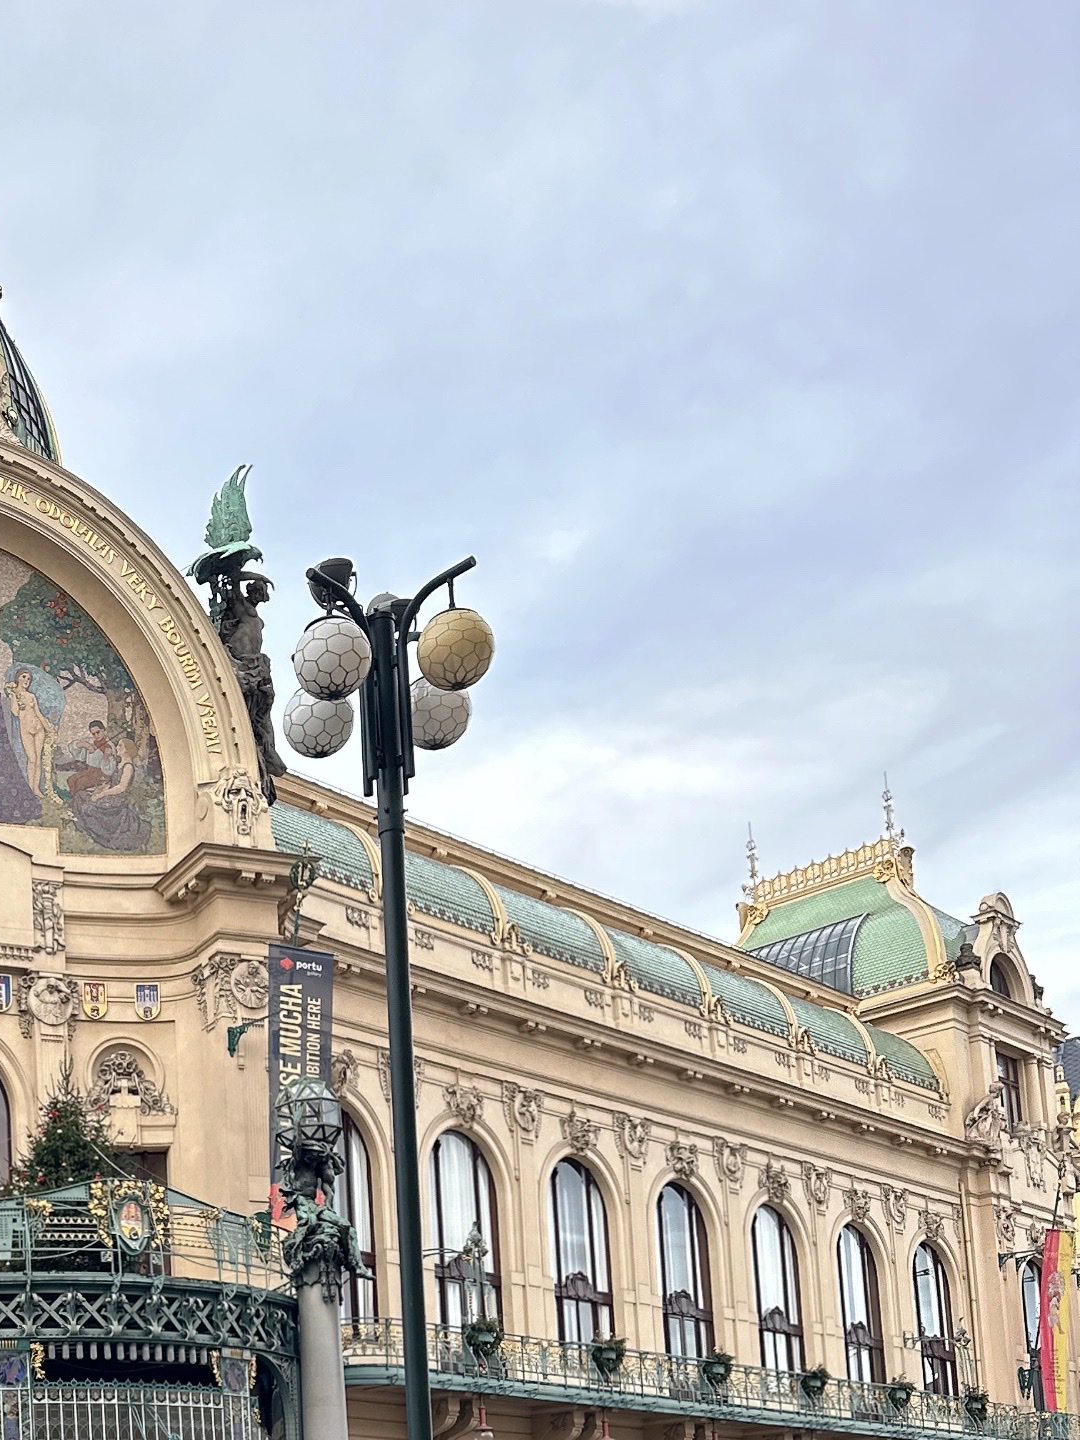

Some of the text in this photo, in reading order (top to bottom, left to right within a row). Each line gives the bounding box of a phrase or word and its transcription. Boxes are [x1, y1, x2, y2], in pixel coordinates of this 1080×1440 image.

[35, 499, 119, 565] ODOLALAS
[296, 961, 323, 972] portu
[279, 983, 302, 1057] MUCHA
[307, 996, 322, 1030] HERE
